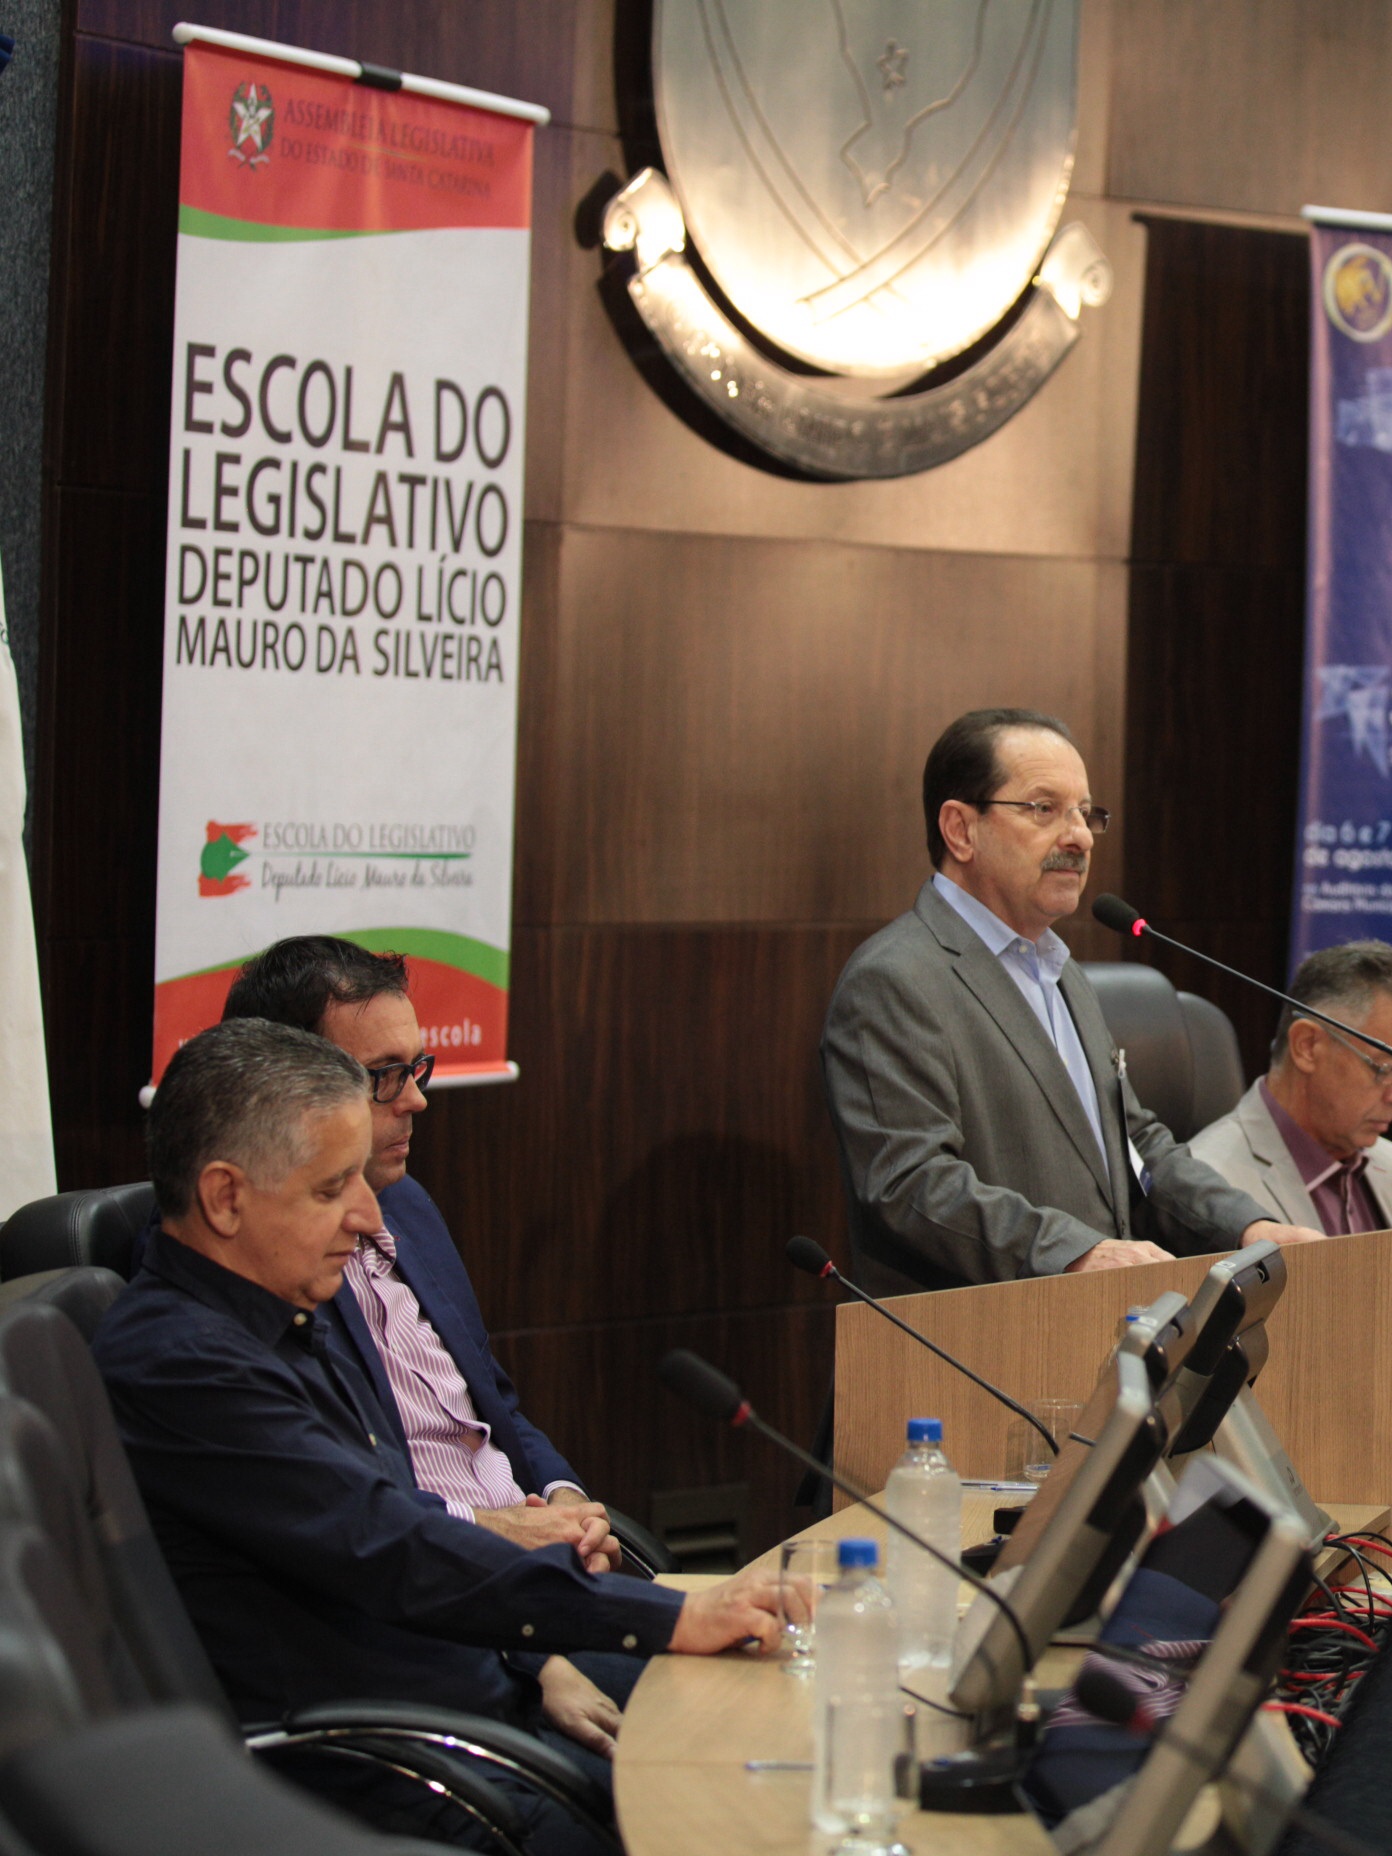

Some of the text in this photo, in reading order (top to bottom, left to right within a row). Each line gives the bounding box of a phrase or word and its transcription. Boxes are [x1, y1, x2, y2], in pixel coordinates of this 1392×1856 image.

[281, 137, 302, 160] DO
[183, 340, 512, 470] ESCOLA DO
[180, 447, 509, 558] LEGISLATIVO
[177, 543, 507, 628] DEPUTADO LÍCIO
[176, 614, 504, 683] MAURO DA SILVEIRA
[263, 822, 476, 851] ESCOLA DO LEGISLATIVO
[1304, 819, 1392, 844] dia 6 e 7
[1303, 847, 1330, 868] de
[261, 860, 321, 903] Deputado
[409, 860, 427, 888] da
